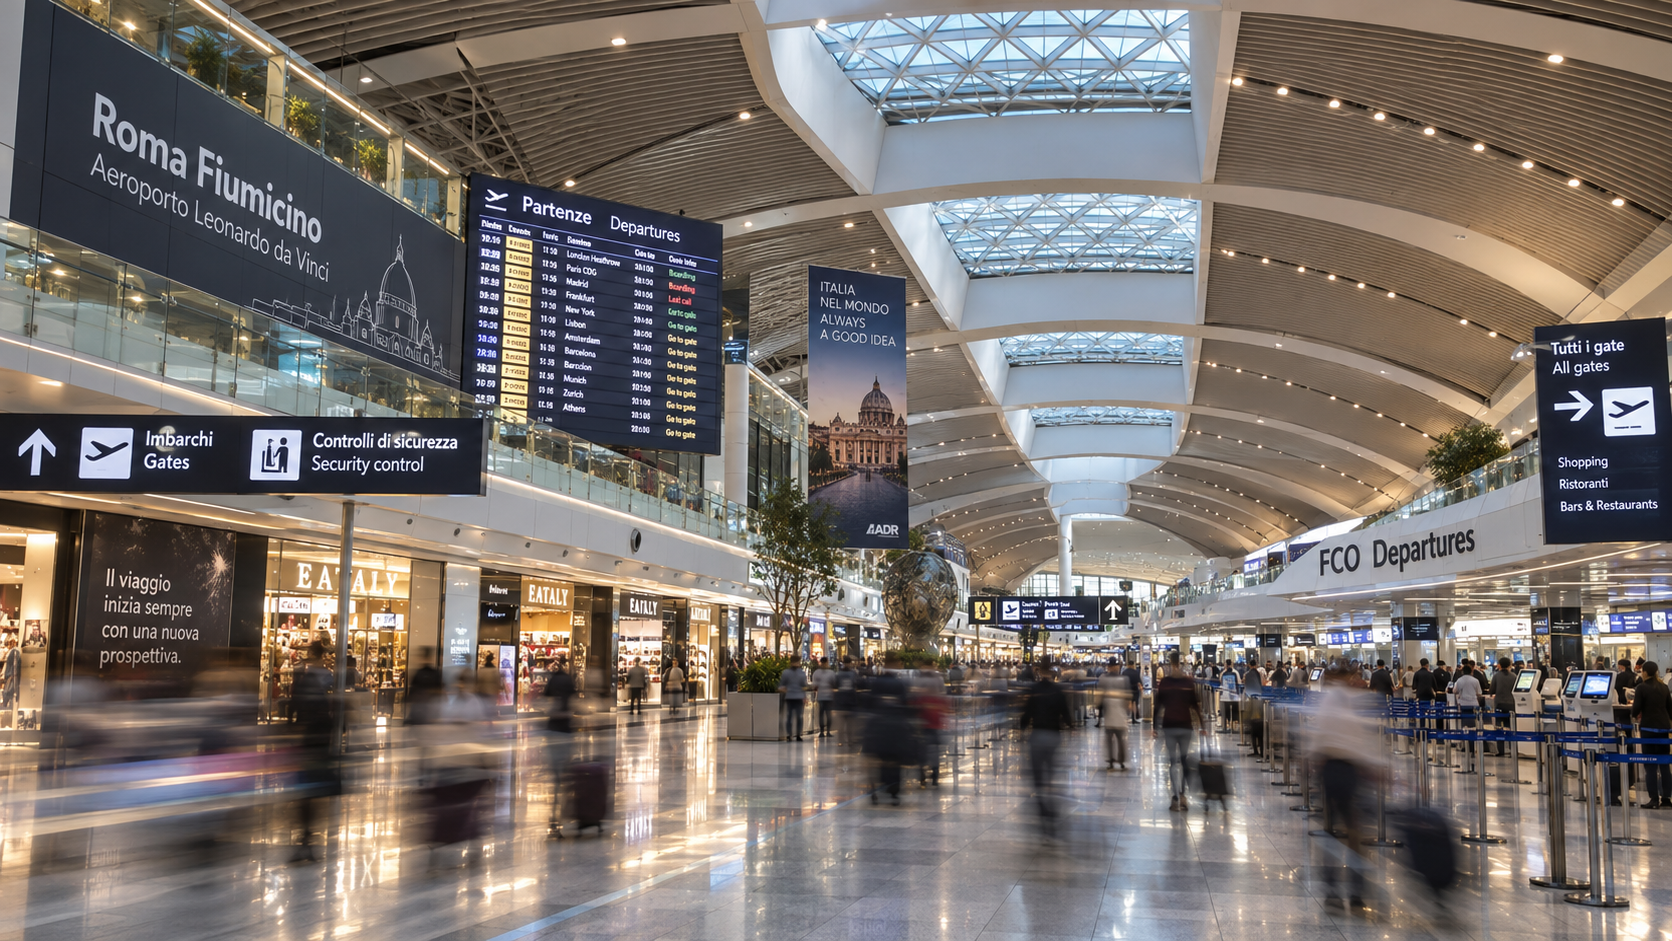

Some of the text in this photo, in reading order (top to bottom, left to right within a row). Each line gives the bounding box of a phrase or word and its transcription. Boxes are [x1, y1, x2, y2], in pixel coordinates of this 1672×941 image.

[92, 92, 323, 244] Roma Fiumicino
[90, 153, 330, 283] Aeroporto Leonardo da Vinci
[522, 195, 592, 225] Partenze
[610, 215, 681, 243] Departures
[566, 277, 589, 288] Madrid
[820, 281, 856, 296] ITALIA
[566, 291, 595, 303] Frankfurt
[820, 297, 890, 315] NEL MONDO
[566, 304, 596, 317] New York
[565, 318, 587, 329] Lisbon
[820, 314, 866, 328] ALWAYS
[565, 332, 600, 345] Amsterdam
[820, 329, 896, 348] A GOOD IDEA
[1551, 339, 1624, 356] Tutti i gate
[564, 347, 596, 358] Barcelona
[1552, 360, 1610, 376] All gates
[564, 374, 587, 385] Munich
[563, 388, 584, 399] Zurich
[562, 403, 586, 414] Athens
[145, 430, 214, 449] Imbarchi
[312, 432, 458, 450] Controlli di sicurezza
[144, 454, 190, 472] Gates
[312, 455, 424, 476] Security control
[1558, 454, 1608, 470] Shopping
[1559, 476, 1609, 490] Ristoranti
[1560, 498, 1658, 512] Bars & Restaurants
[1320, 527, 1476, 576] FCO Departures
[106, 568, 172, 595] Il viaggio
[296, 562, 398, 595] EAALY
[528, 584, 568, 606] EATALY
[104, 594, 194, 619] inizia sempre
[102, 623, 200, 642] con una nuova
[100, 647, 182, 669] prospettiva.
